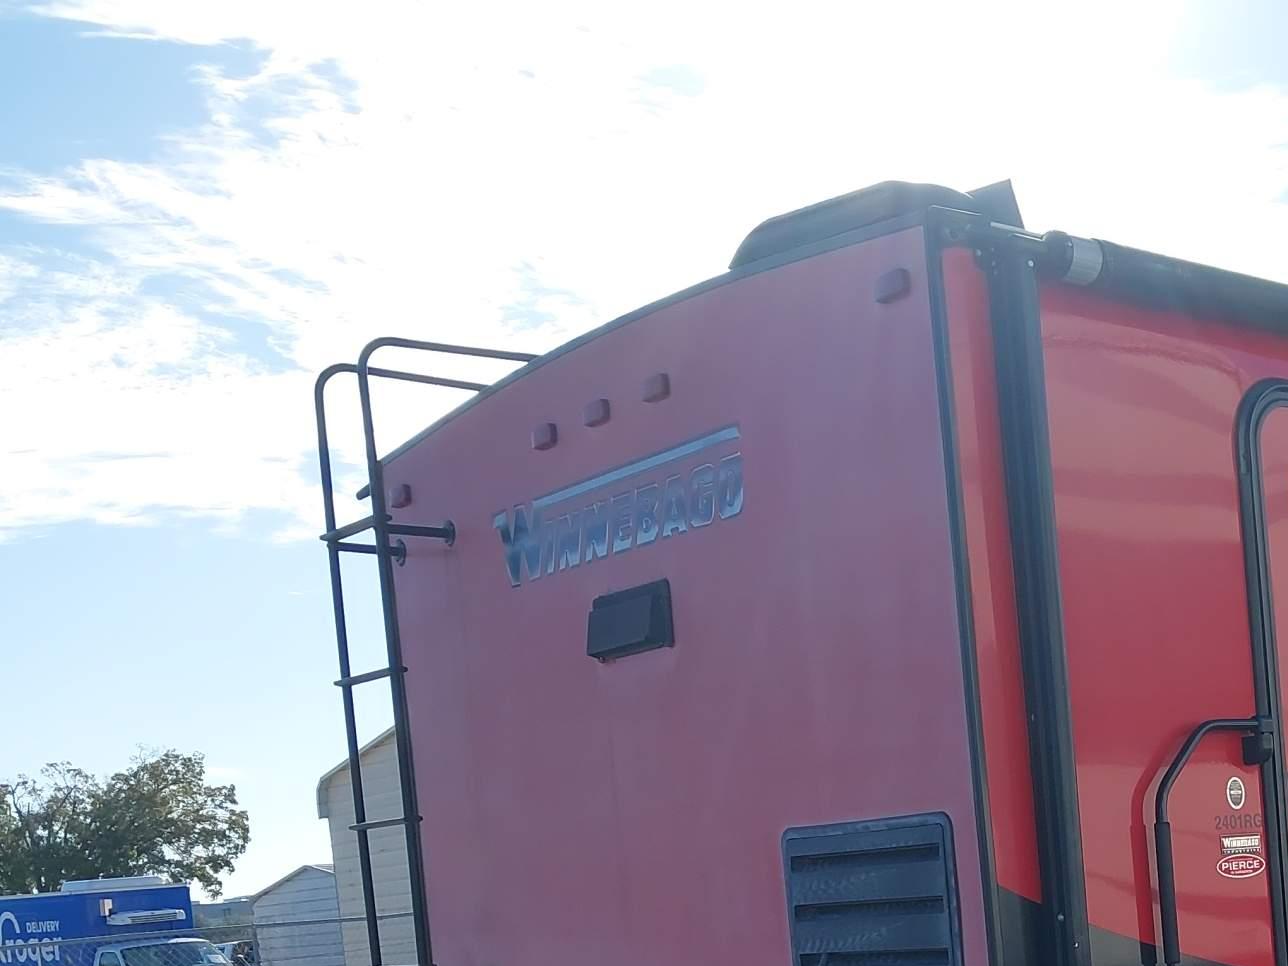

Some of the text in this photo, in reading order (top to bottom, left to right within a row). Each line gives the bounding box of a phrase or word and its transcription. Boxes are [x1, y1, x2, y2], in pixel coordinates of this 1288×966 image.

[493, 451, 745, 587] WINNEBAGO
[1215, 814, 1262, 829] 2401RG
[1221, 860, 1260, 871] PIERCE
[26, 920, 60, 933] DELIVERY
